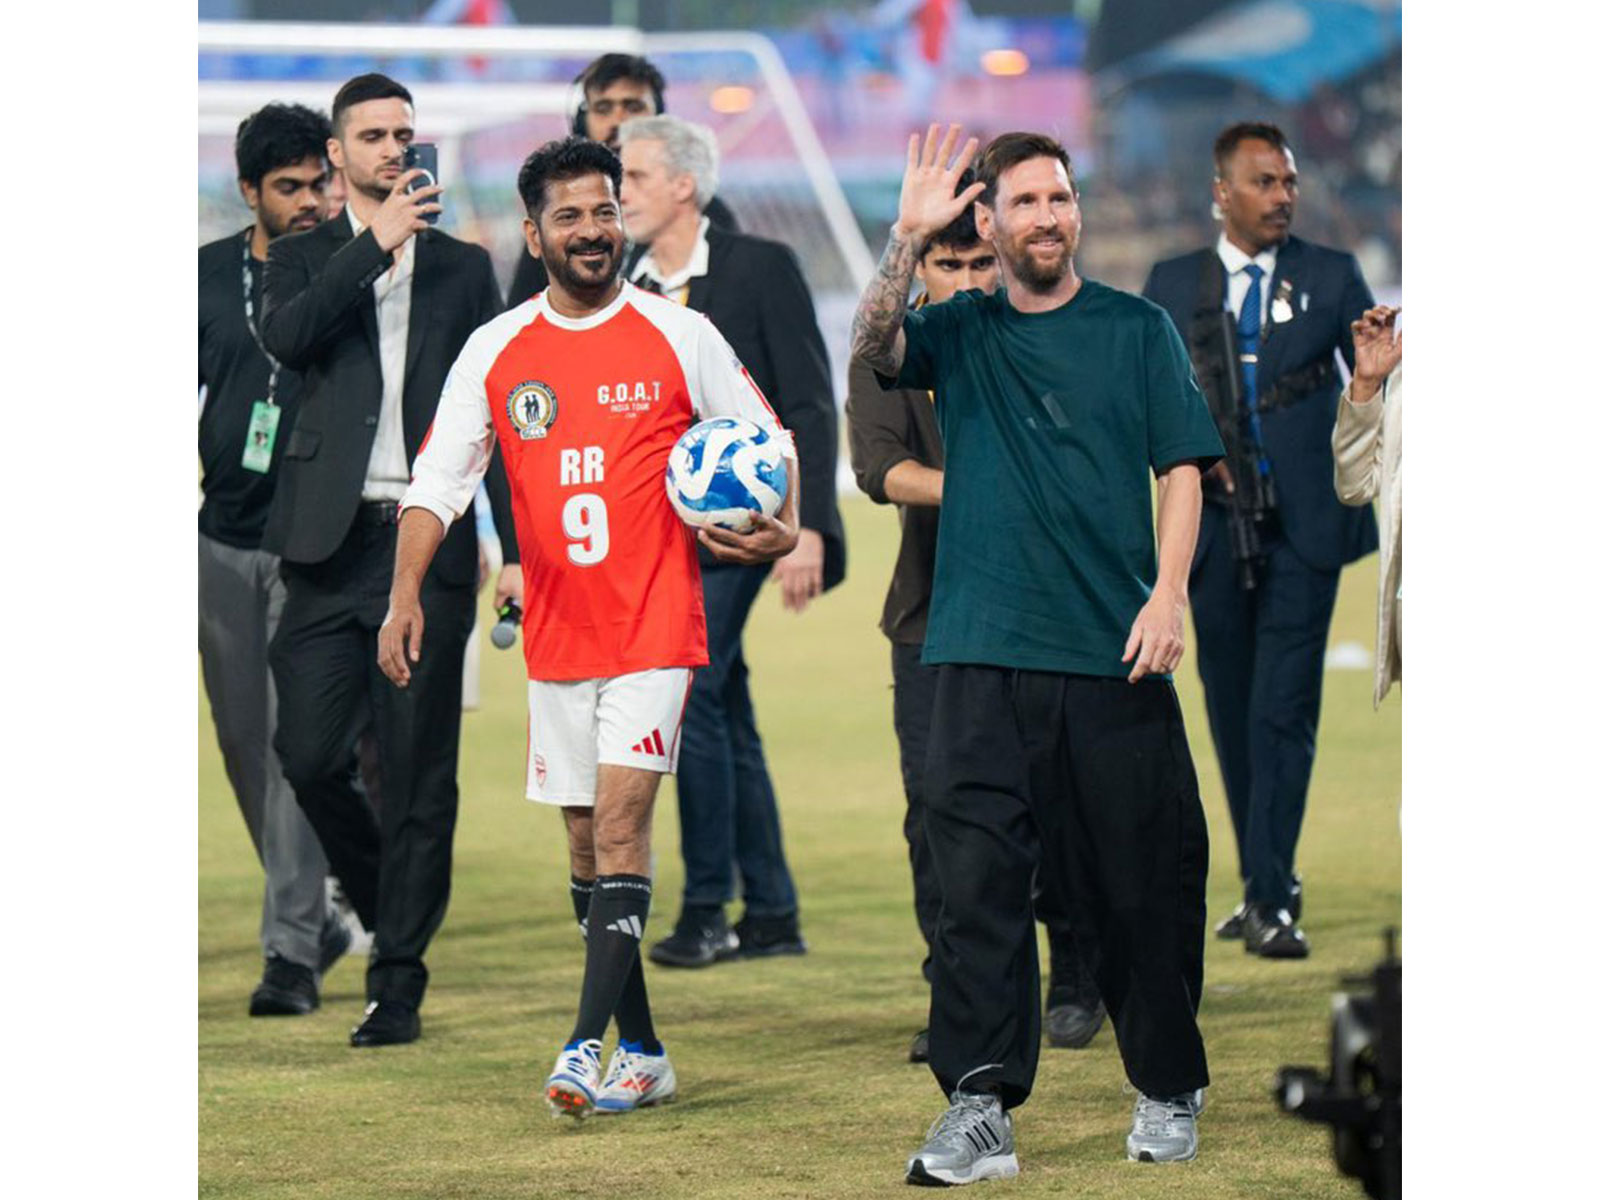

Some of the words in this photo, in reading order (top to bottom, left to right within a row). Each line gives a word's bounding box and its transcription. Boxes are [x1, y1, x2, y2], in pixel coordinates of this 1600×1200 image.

[597, 382, 661, 405] G.O.A.T
[560, 446, 604, 486] RR
[562, 493, 609, 566] 9
